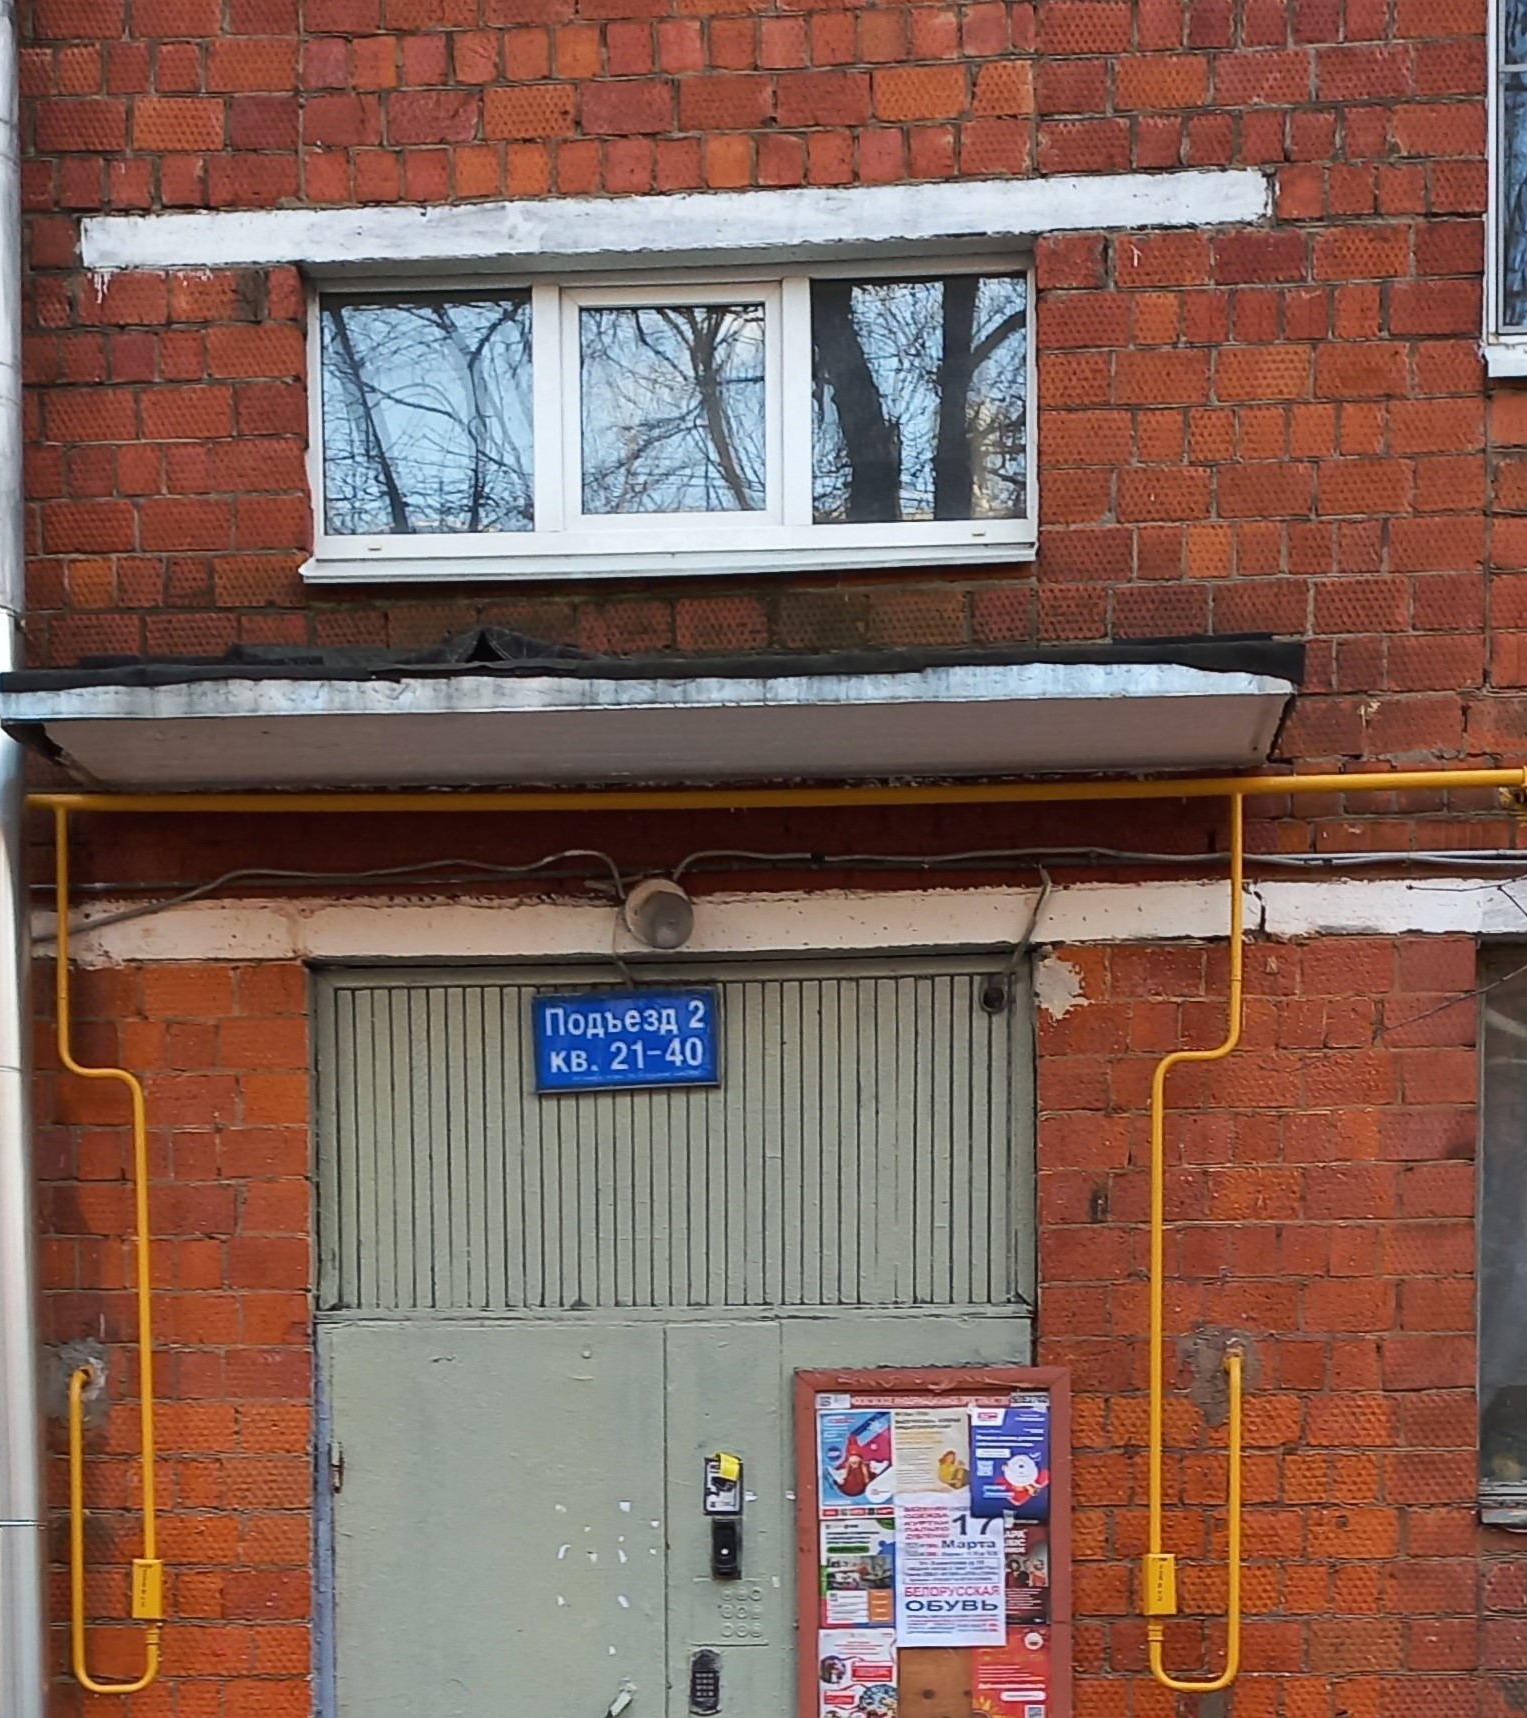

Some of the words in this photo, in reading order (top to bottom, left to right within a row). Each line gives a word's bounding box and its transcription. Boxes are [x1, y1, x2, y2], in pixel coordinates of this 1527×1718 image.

[545, 1007, 678, 1039] Подъезд
[687, 1000, 706, 1029] 2
[549, 1049, 599, 1074] кв.
[609, 1037, 704, 1070] 21-40
[952, 1514, 998, 1535] 17
[941, 1540, 996, 1550] Марта
[904, 1586, 1000, 1597] БЕЛОРУССКАЯ
[905, 1599, 999, 1612] ОБУВЬ
